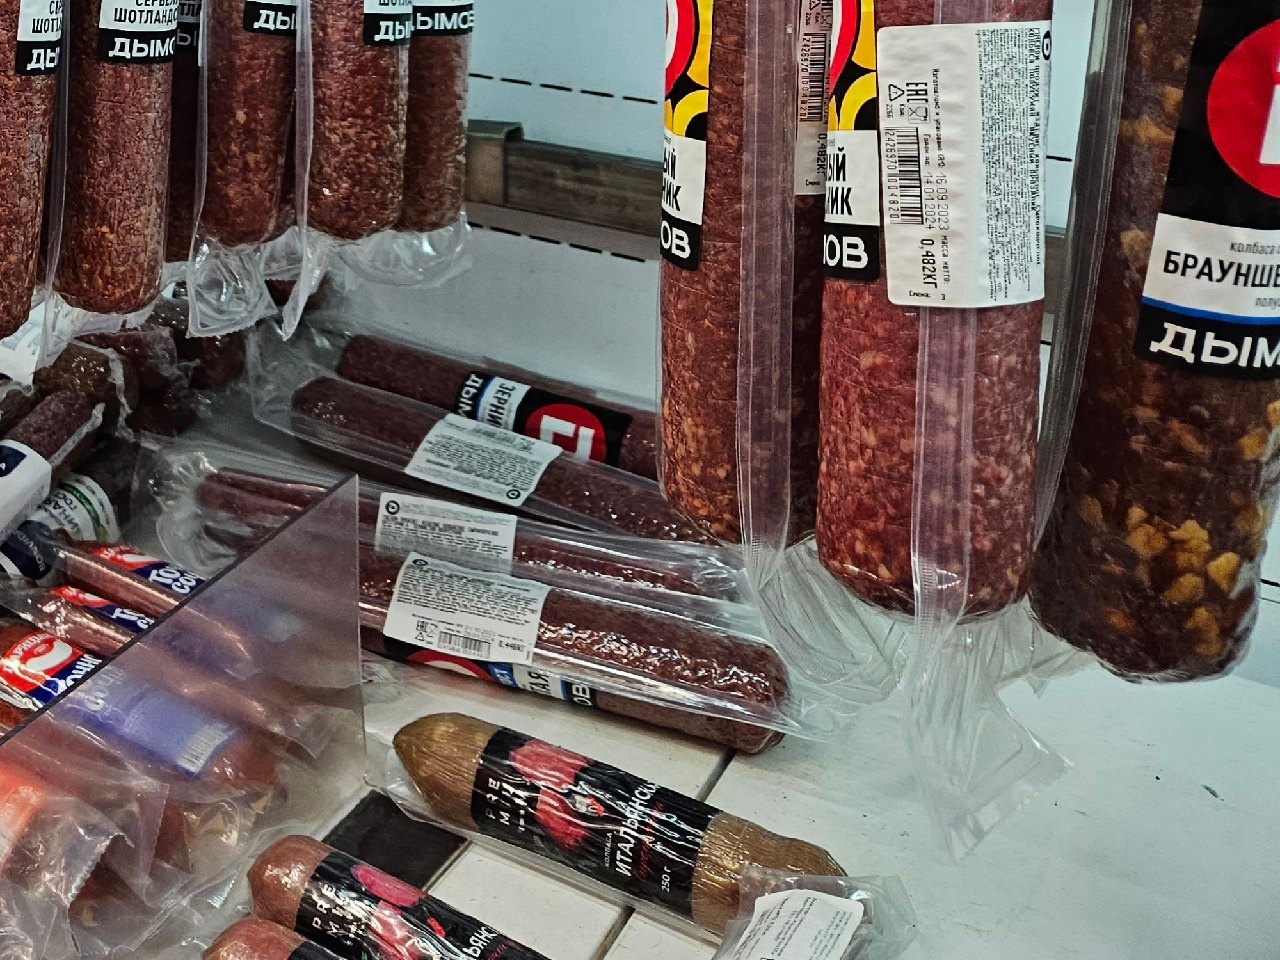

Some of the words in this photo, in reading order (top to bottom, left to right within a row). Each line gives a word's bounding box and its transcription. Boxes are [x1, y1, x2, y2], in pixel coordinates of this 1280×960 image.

[886, 132, 898, 170] 2426970
[887, 178, 900, 219] 004820
[923, 172, 936, 230] 14.01.2024
[936, 172, 950, 231] 16.09.2023
[918, 238, 938, 288] 0,482КГ
